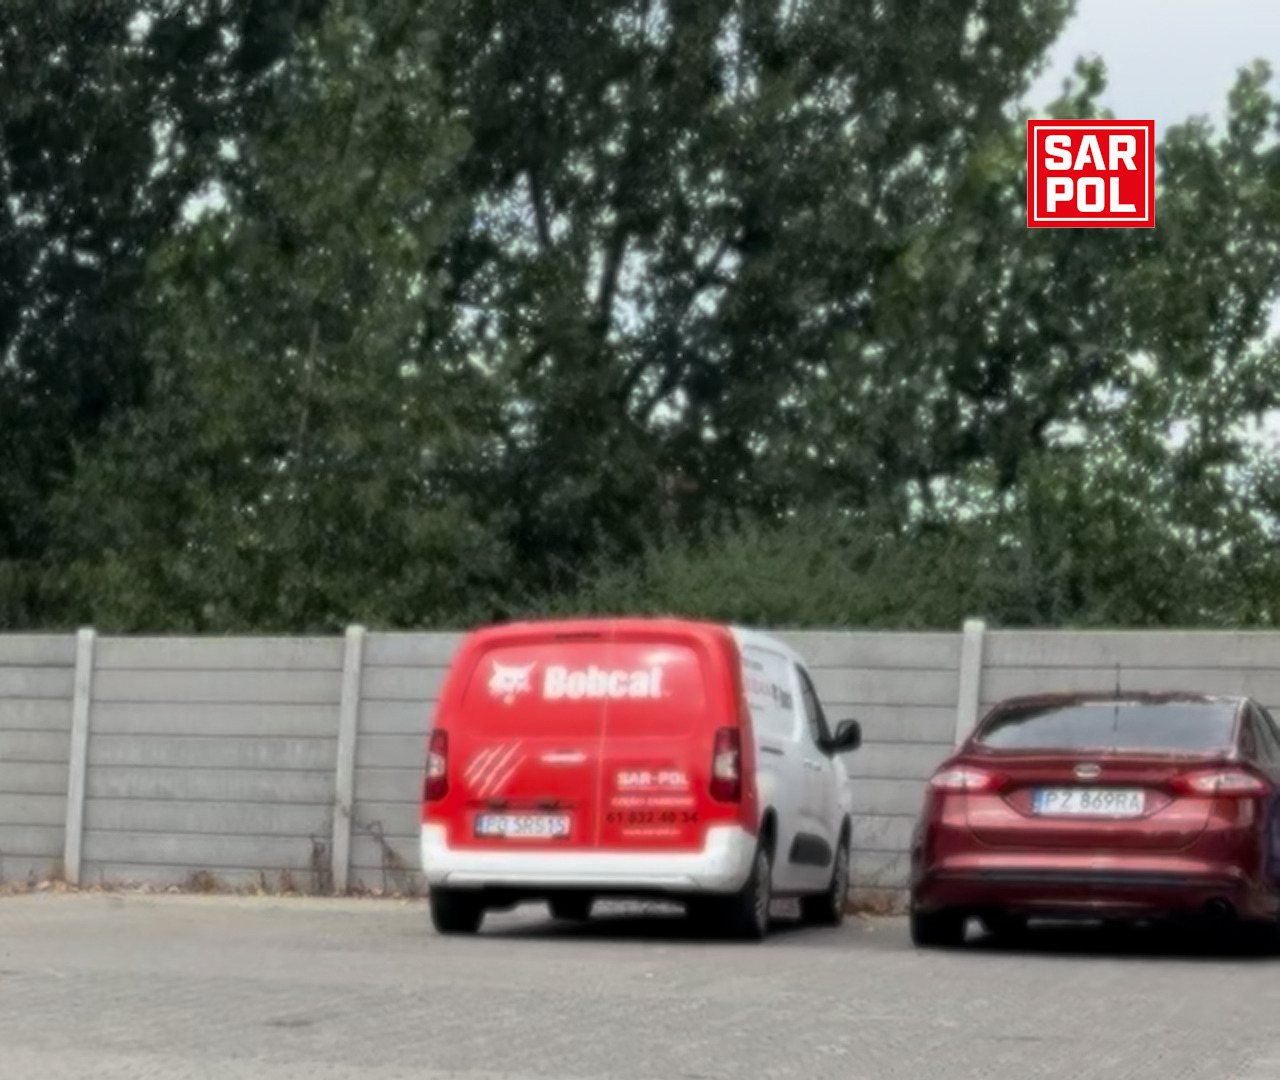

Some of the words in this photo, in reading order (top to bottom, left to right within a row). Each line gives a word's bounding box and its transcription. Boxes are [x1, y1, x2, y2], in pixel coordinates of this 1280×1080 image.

[543, 665, 663, 699] Bobcat
[617, 771, 690, 785] SAR-POL
[1046, 790, 1074, 809] PZ
[1080, 791, 1139, 810] 869RA
